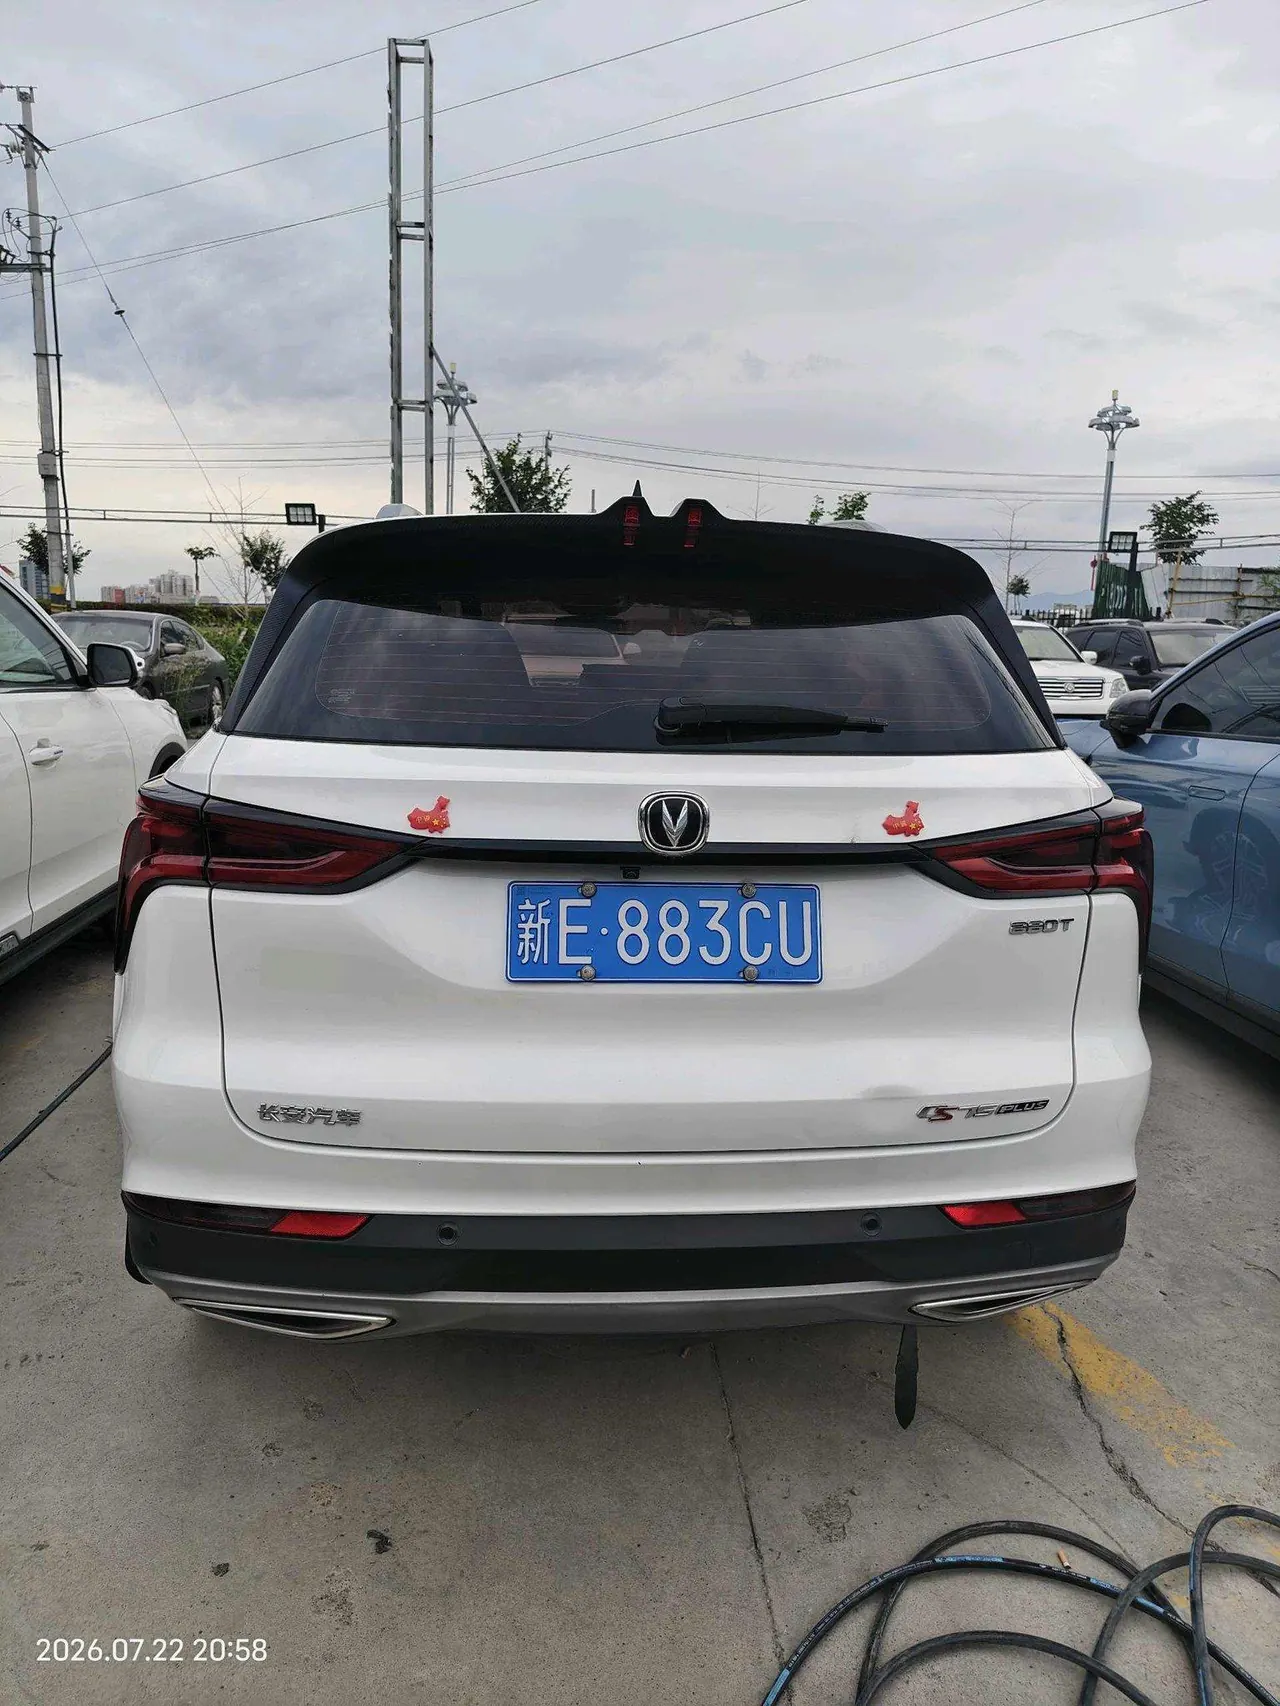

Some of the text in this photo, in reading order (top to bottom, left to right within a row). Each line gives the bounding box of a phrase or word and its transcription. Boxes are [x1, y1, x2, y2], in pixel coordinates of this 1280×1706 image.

[257, 1102, 361, 1126] 长安汽车
[998, 1100, 1049, 1115] PLUS
